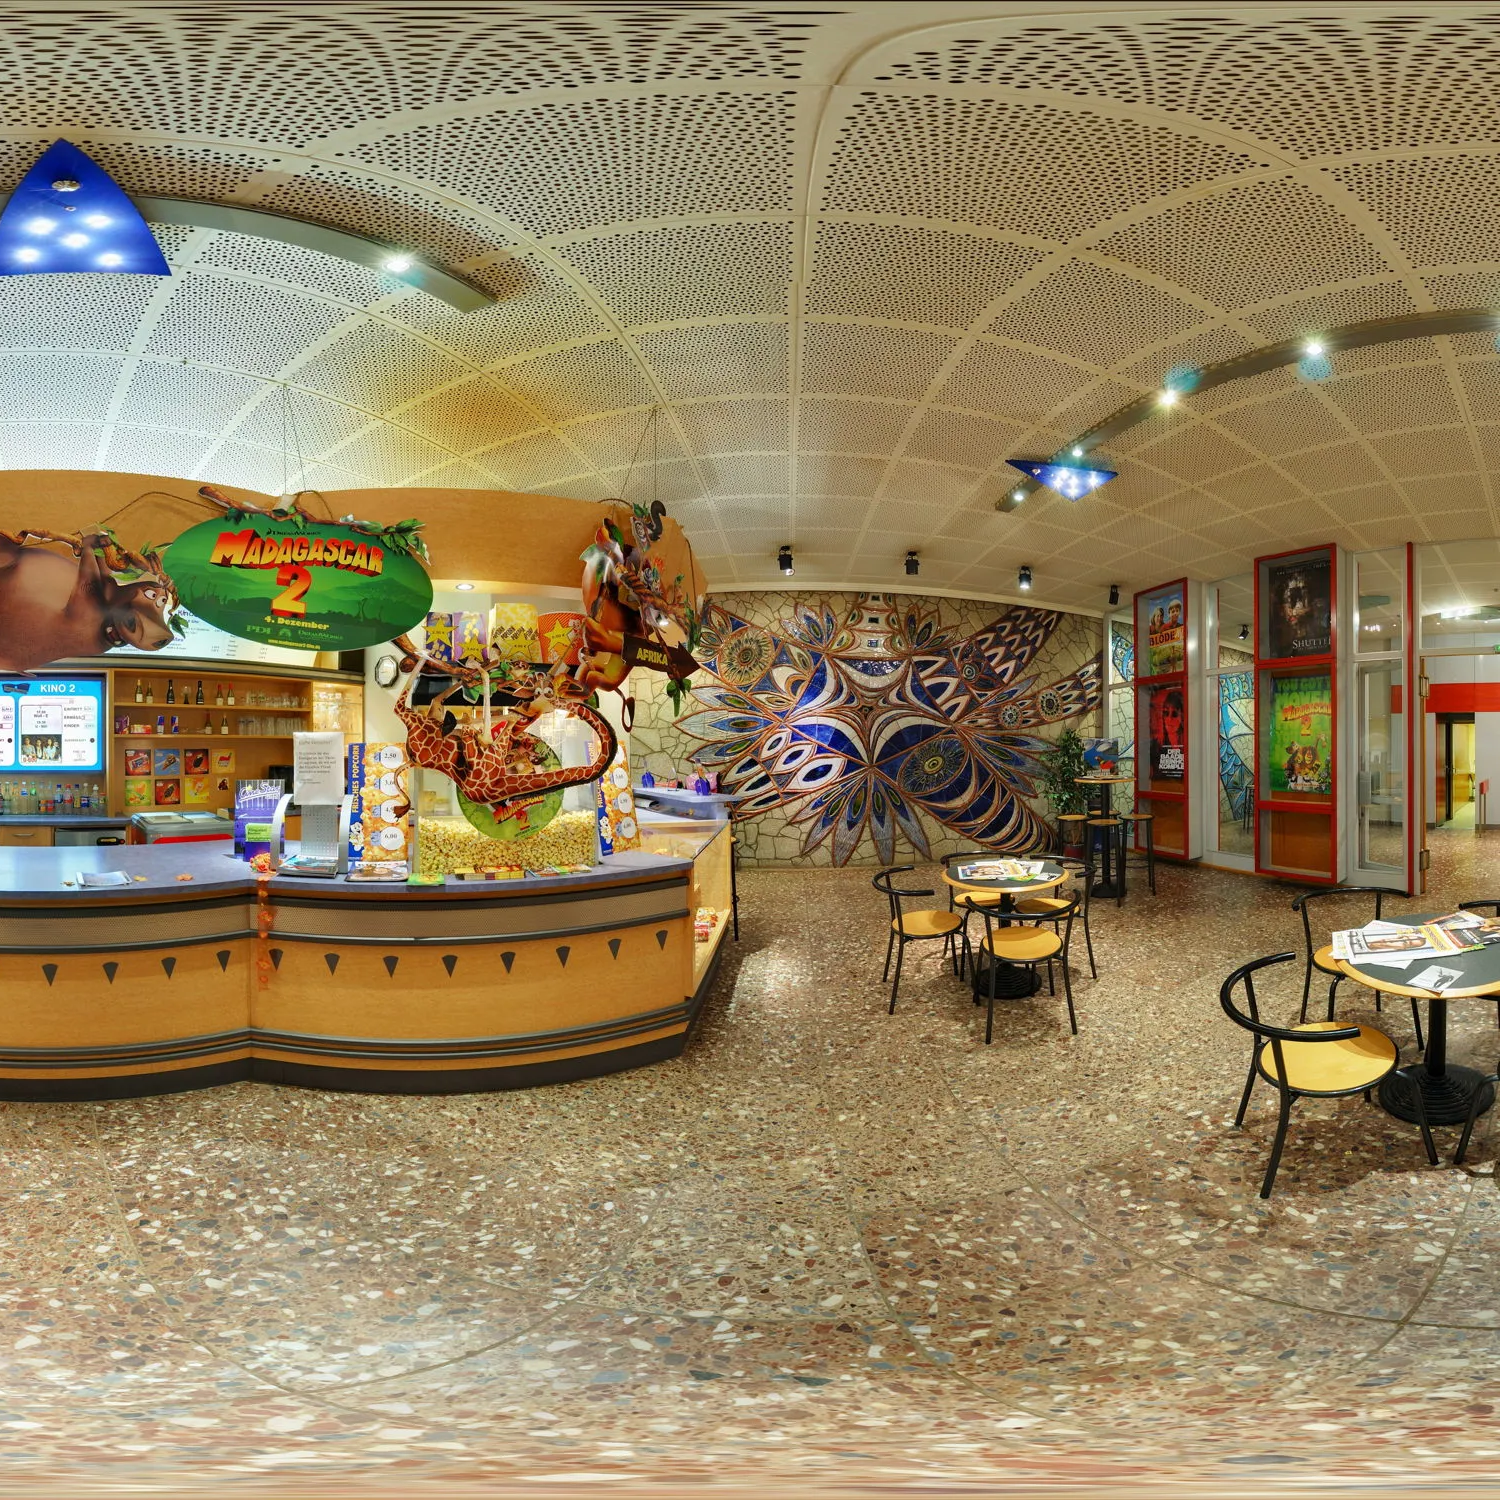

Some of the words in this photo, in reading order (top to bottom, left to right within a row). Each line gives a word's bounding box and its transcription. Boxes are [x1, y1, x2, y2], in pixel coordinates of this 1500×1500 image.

[209, 529, 384, 577] MADAGASCAR
[270, 564, 312, 619] 2
[264, 615, 275, 624] 4.
[277, 617, 330, 631] Dezember
[636, 647, 669, 666] AFRIKA
[40, 684, 67, 693] KINO
[69, 684, 76, 693] 2
[1300, 715, 1313, 737] 2
[352, 744, 361, 778] POPCORN
[351, 780, 360, 813] FRISCHES
